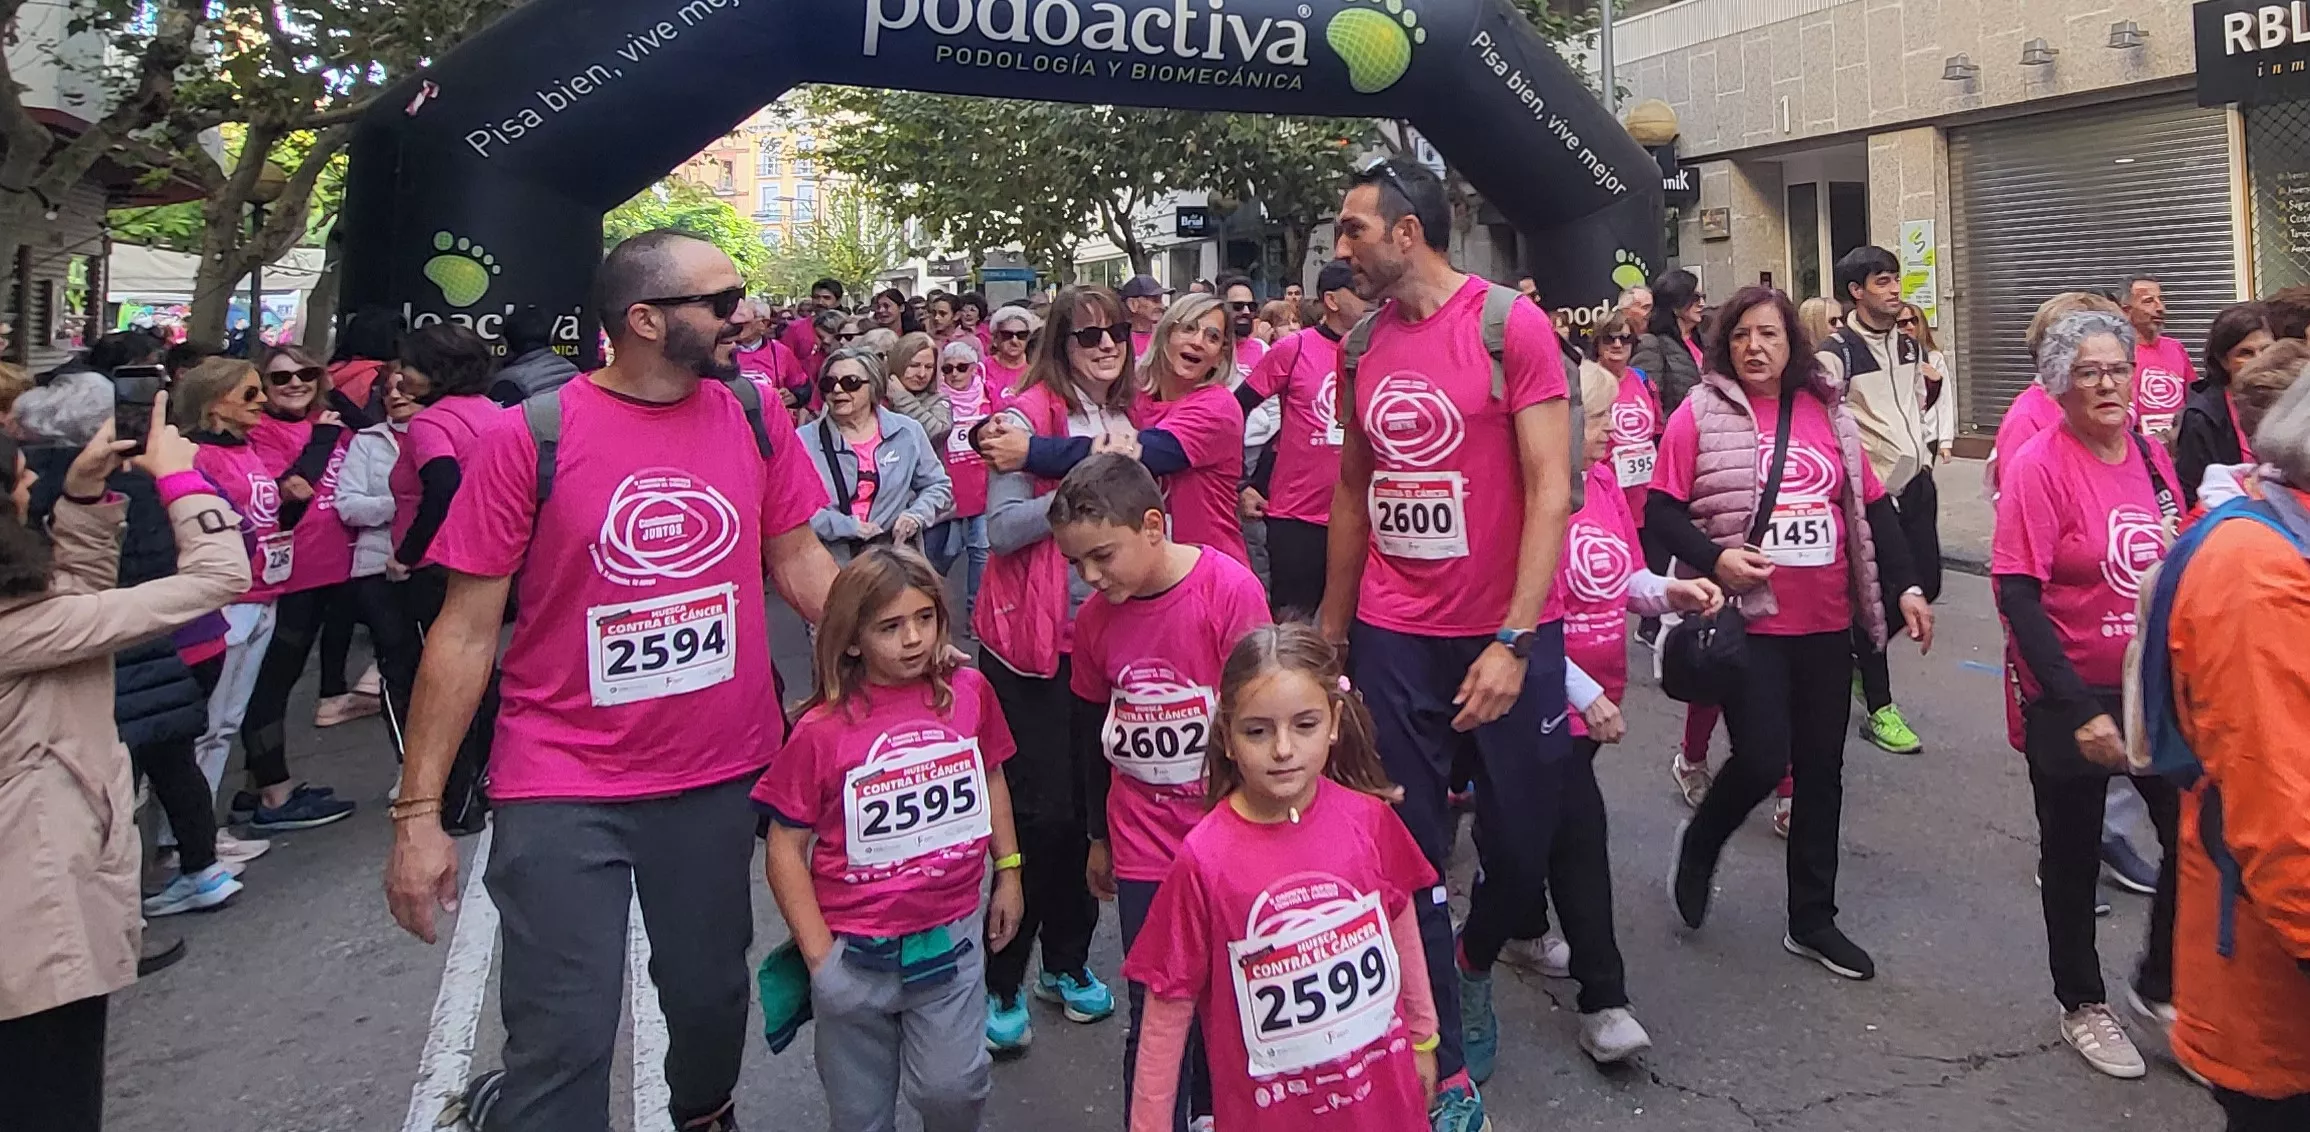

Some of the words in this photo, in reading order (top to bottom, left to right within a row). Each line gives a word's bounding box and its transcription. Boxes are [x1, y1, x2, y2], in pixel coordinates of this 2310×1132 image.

[935, 44, 1096, 77] PODOLOGÍA
[1106, 60, 1122, 78] Y
[1131, 61, 1303, 91] BIOMECÁNICA
[465, 104, 546, 159] Pisa
[537, 58, 624, 115] bien,
[617, 20, 679, 64] vive
[1471, 30, 1508, 77] Pisa
[1507, 70, 1546, 120] bien,
[1547, 113, 1580, 151] vive
[1577, 147, 1628, 196] mejor
[1627, 456, 1653, 474] 395
[642, 523, 682, 541] JUNTOS
[1377, 501, 1452, 534] 2600
[1769, 519, 1830, 546] 1451
[607, 618, 662, 635] CONTRA
[664, 612, 678, 625] EL
[679, 603, 723, 621] CÁNCER
[651, 605, 688, 618] HUESCA
[606, 619, 726, 676] 2594
[1159, 706, 1201, 720] CÁNCER
[1112, 722, 1207, 758] 2602
[863, 773, 914, 796] CONTRA
[915, 772, 928, 785] EL
[929, 759, 972, 779] CÁNCER
[903, 761, 936, 776] HUESCA
[862, 776, 976, 836] 2595
[1251, 953, 1312, 978] CONTRA
[1314, 947, 1330, 963] EL
[1331, 921, 1377, 952] CÁNCER
[1297, 930, 1338, 954] HUESCA
[1255, 946, 1386, 1033] 2599
